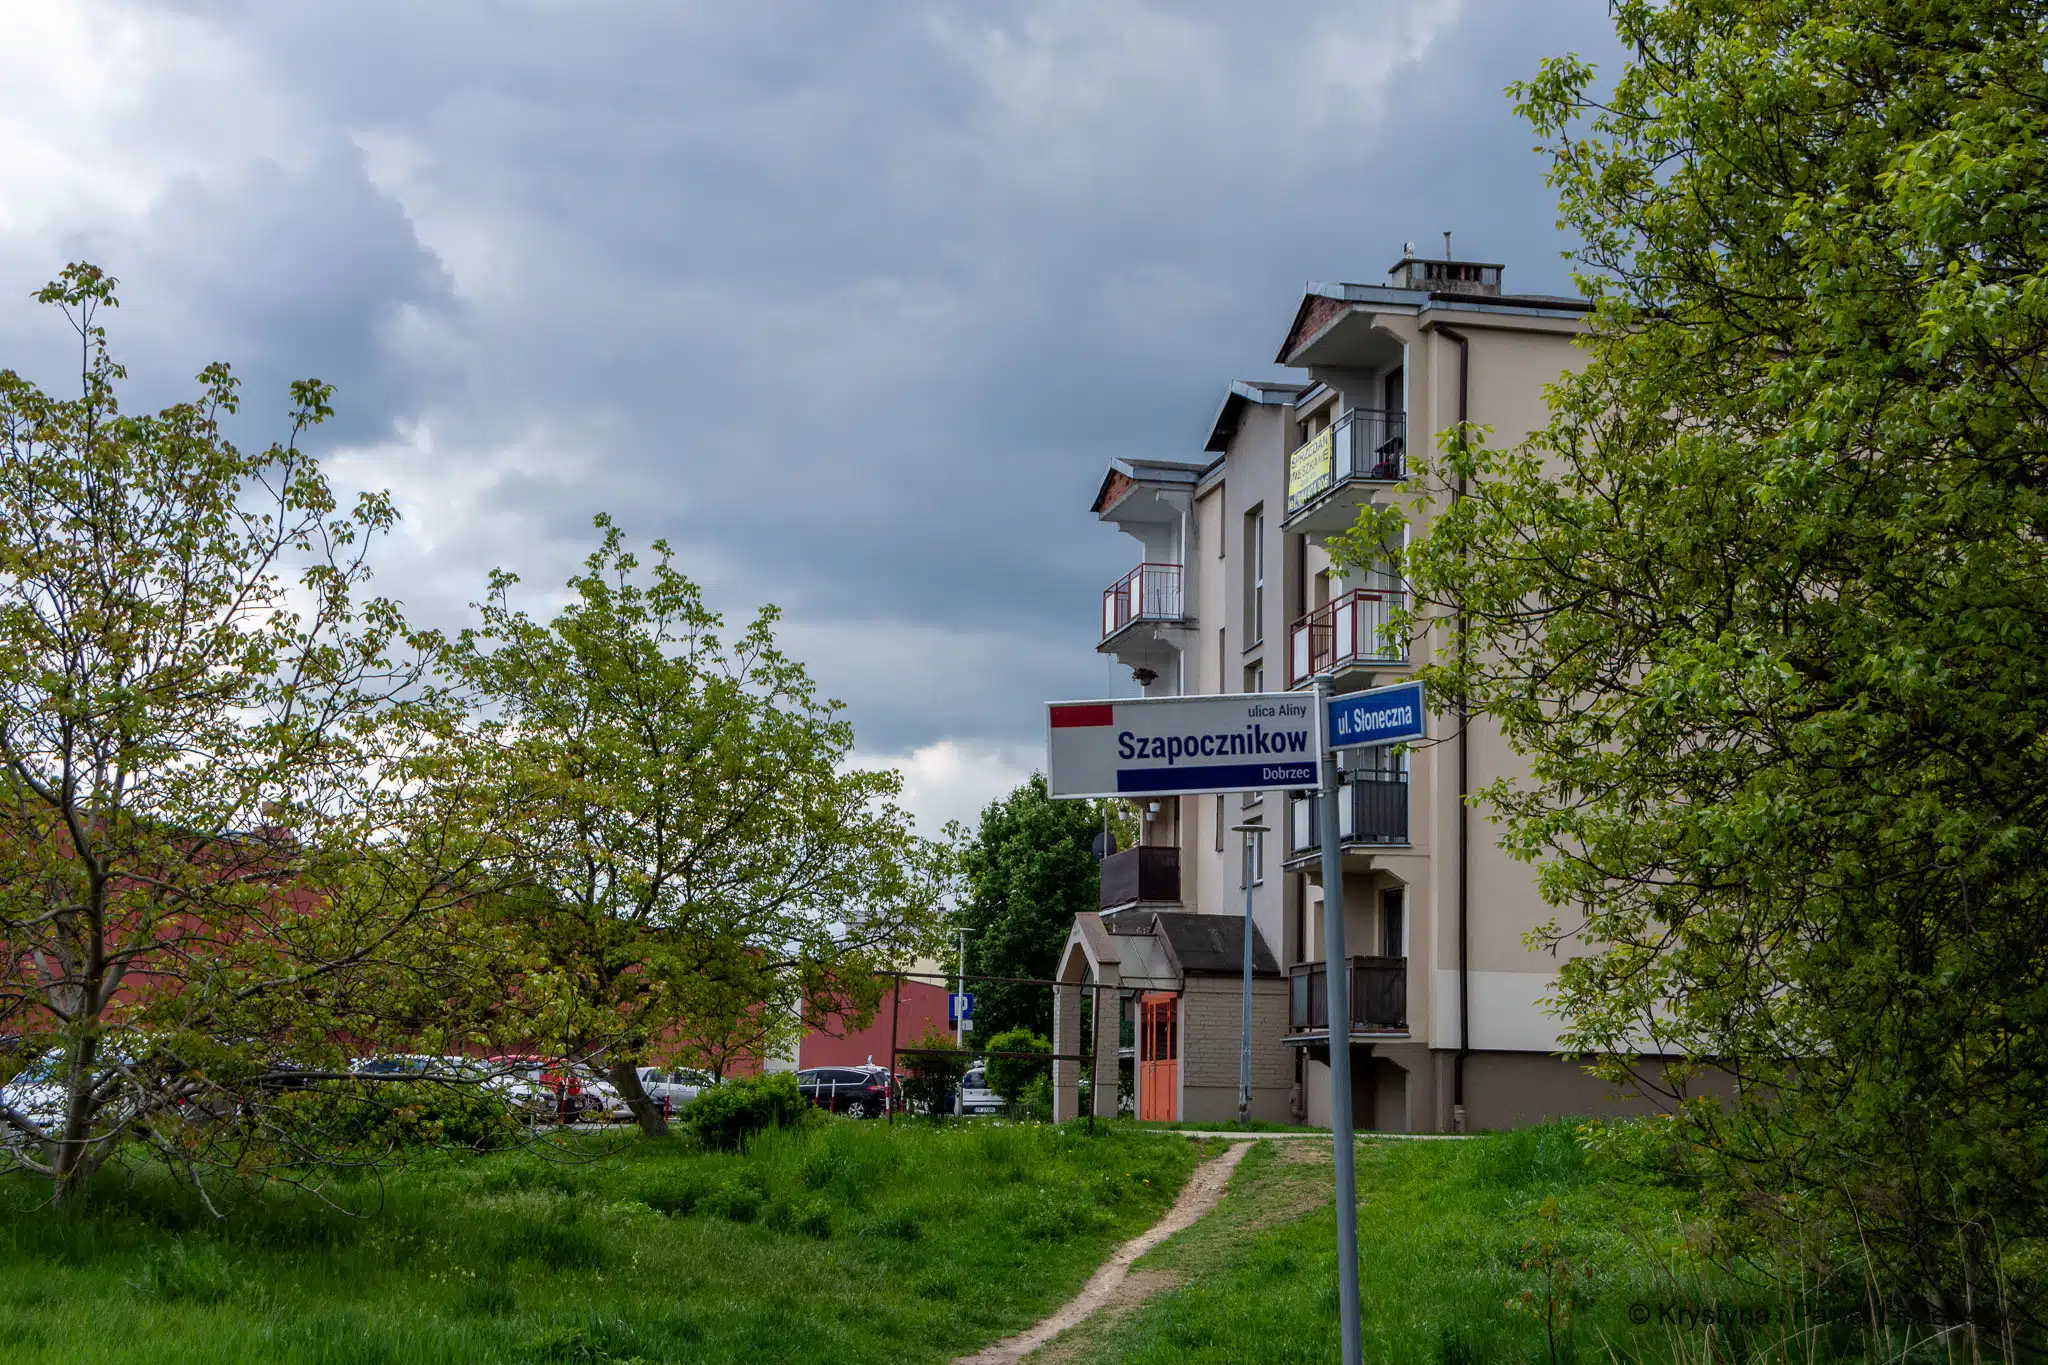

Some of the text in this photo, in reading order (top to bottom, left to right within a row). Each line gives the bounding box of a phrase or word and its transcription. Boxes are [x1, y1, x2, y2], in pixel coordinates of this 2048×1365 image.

[1248, 704, 1307, 719] ulica Aliny
[1338, 711, 1352, 735] ul.
[1117, 724, 1308, 765] Szapocznikow
[1262, 767, 1311, 780] Dobrzec
[954, 996, 969, 1017] P
